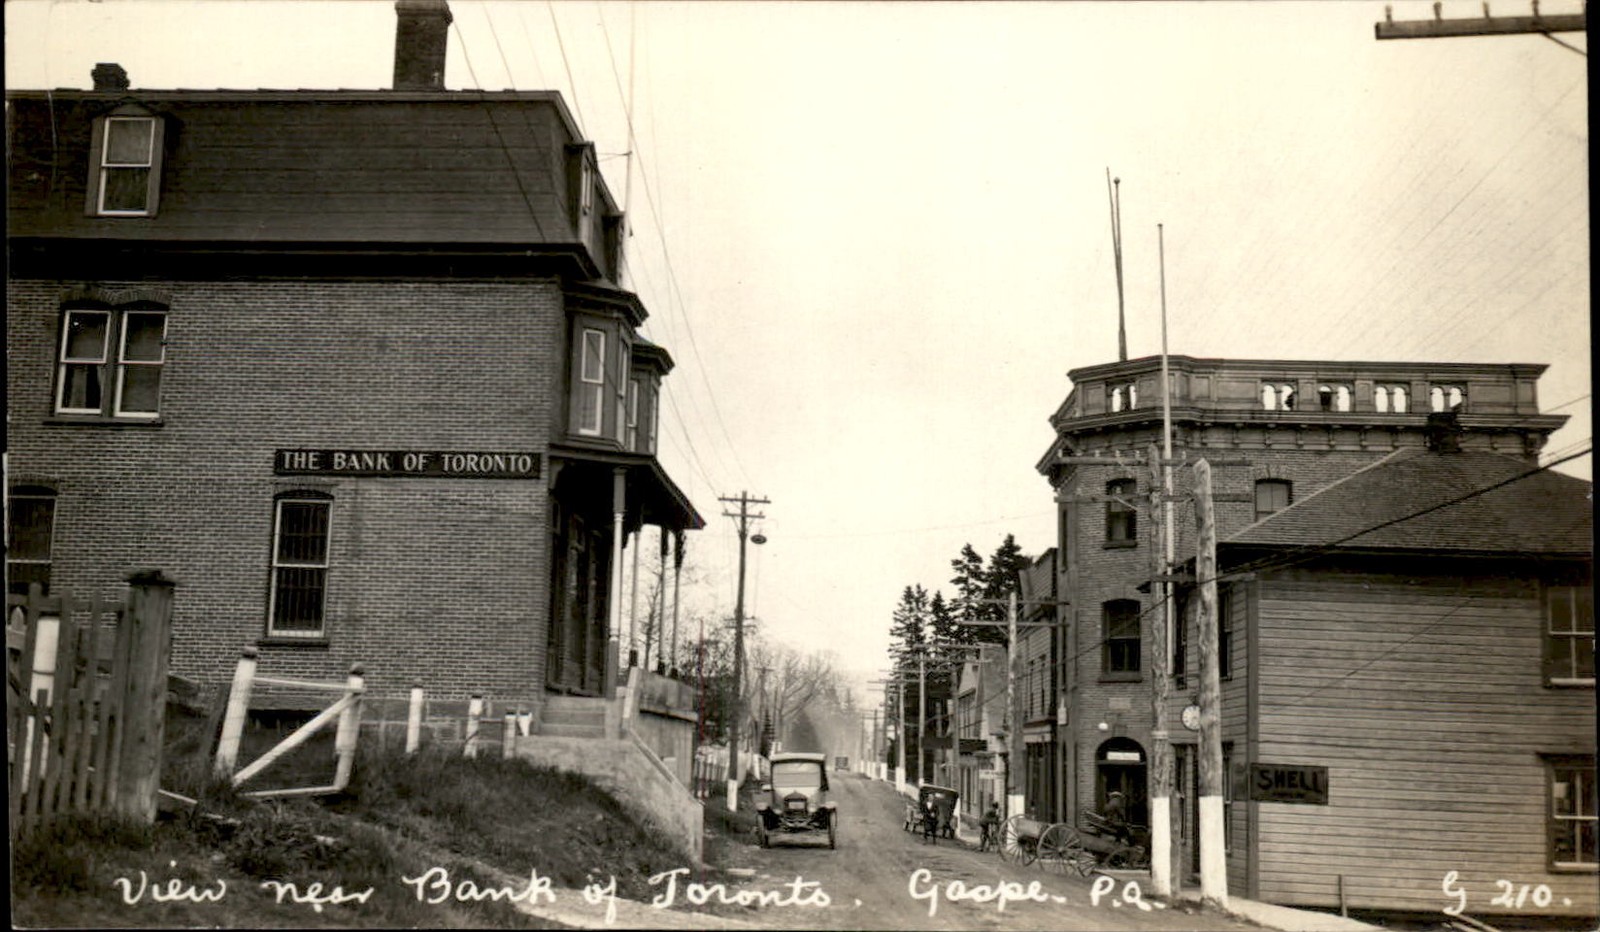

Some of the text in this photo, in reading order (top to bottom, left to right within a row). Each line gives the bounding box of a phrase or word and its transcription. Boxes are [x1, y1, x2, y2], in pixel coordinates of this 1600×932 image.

[282, 452, 533, 473] THE BANK OF TORONTO
